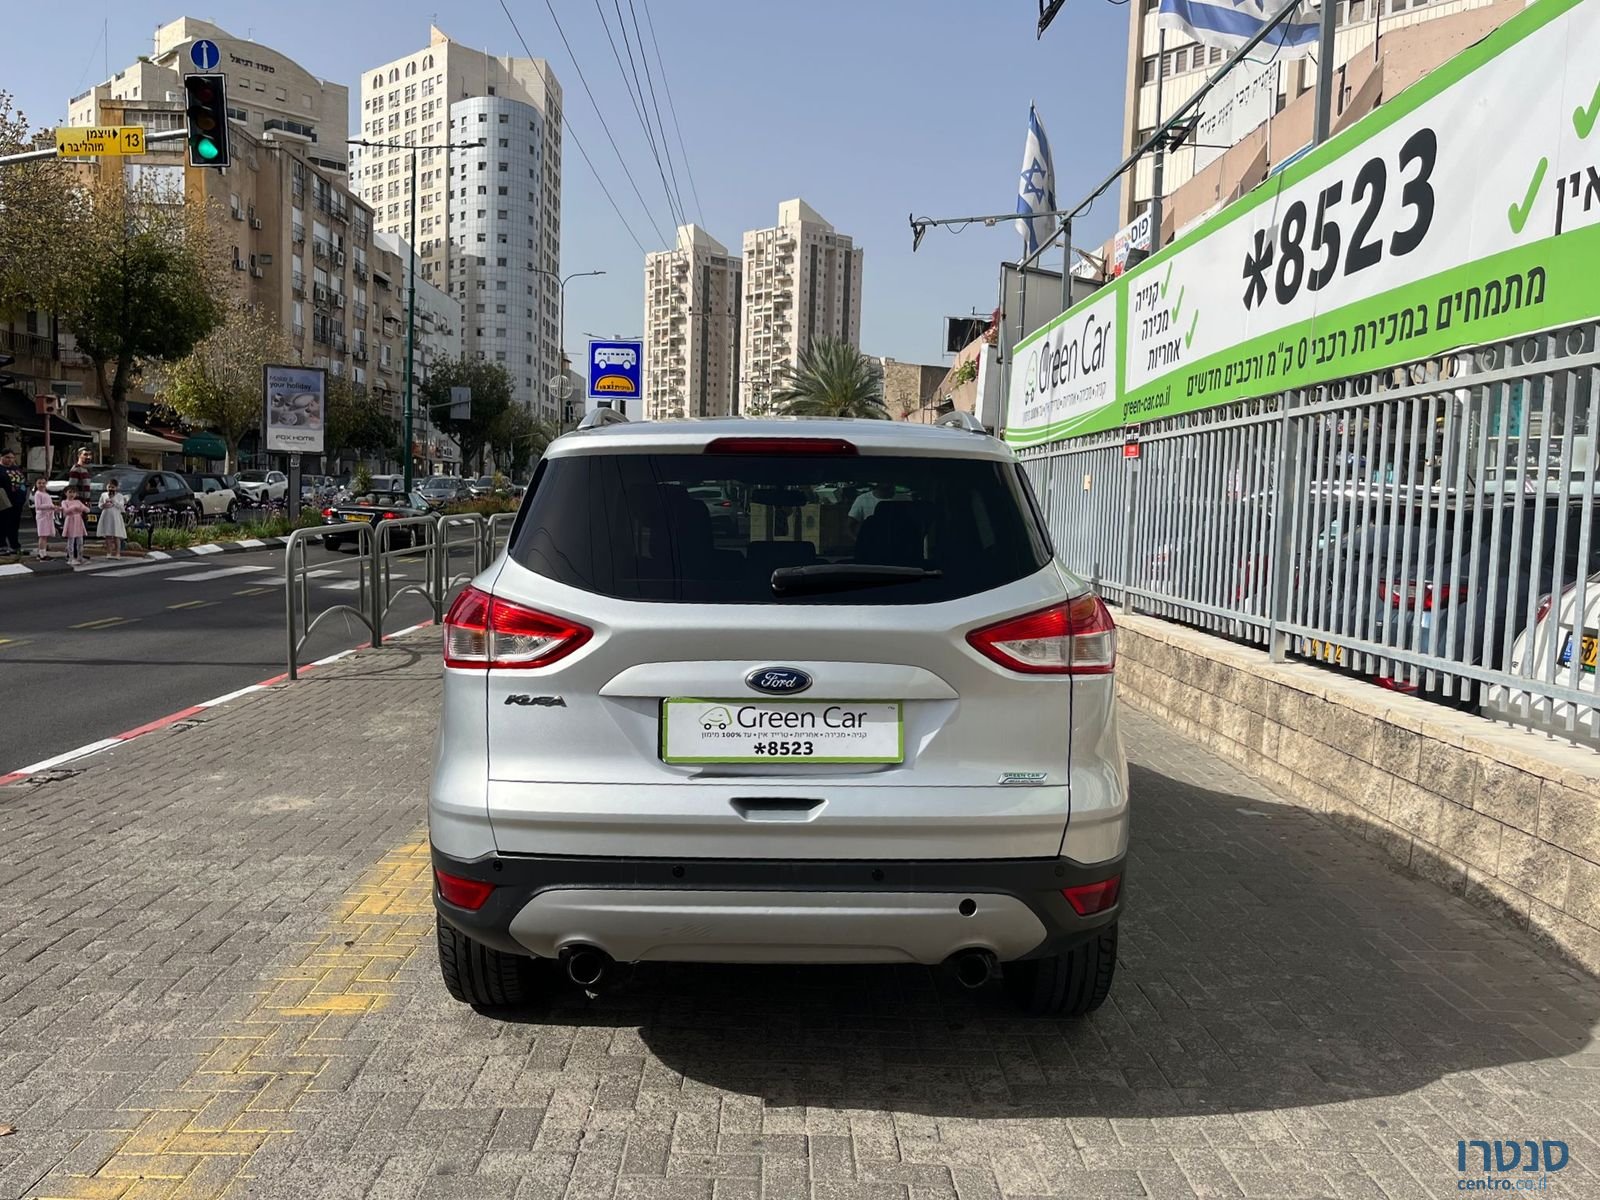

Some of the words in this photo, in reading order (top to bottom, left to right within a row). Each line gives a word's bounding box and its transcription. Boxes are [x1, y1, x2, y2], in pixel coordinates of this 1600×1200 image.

[67, 140, 105, 152] מוהליבר
[86, 129, 111, 141] ויצמן
[124, 133, 140, 147] 13
[1135, 281, 1160, 313] קנייה
[1436, 266, 1546, 331] מתמחים
[1141, 309, 1170, 341] מכירה
[1351, 304, 1428, 355] במכירת
[1038, 339, 1078, 394] Green
[1081, 314, 1111, 376] Car
[1147, 337, 1182, 371] אחריות
[1311, 329, 1347, 365] רכבי
[1186, 367, 1222, 397] חדשים
[1224, 354, 1264, 387] ורכבים
[1123, 384, 1171, 421] green-car.co.il
[761, 672, 797, 687] Ford
[737, 706, 815, 729] Green
[823, 706, 867, 729] Car
